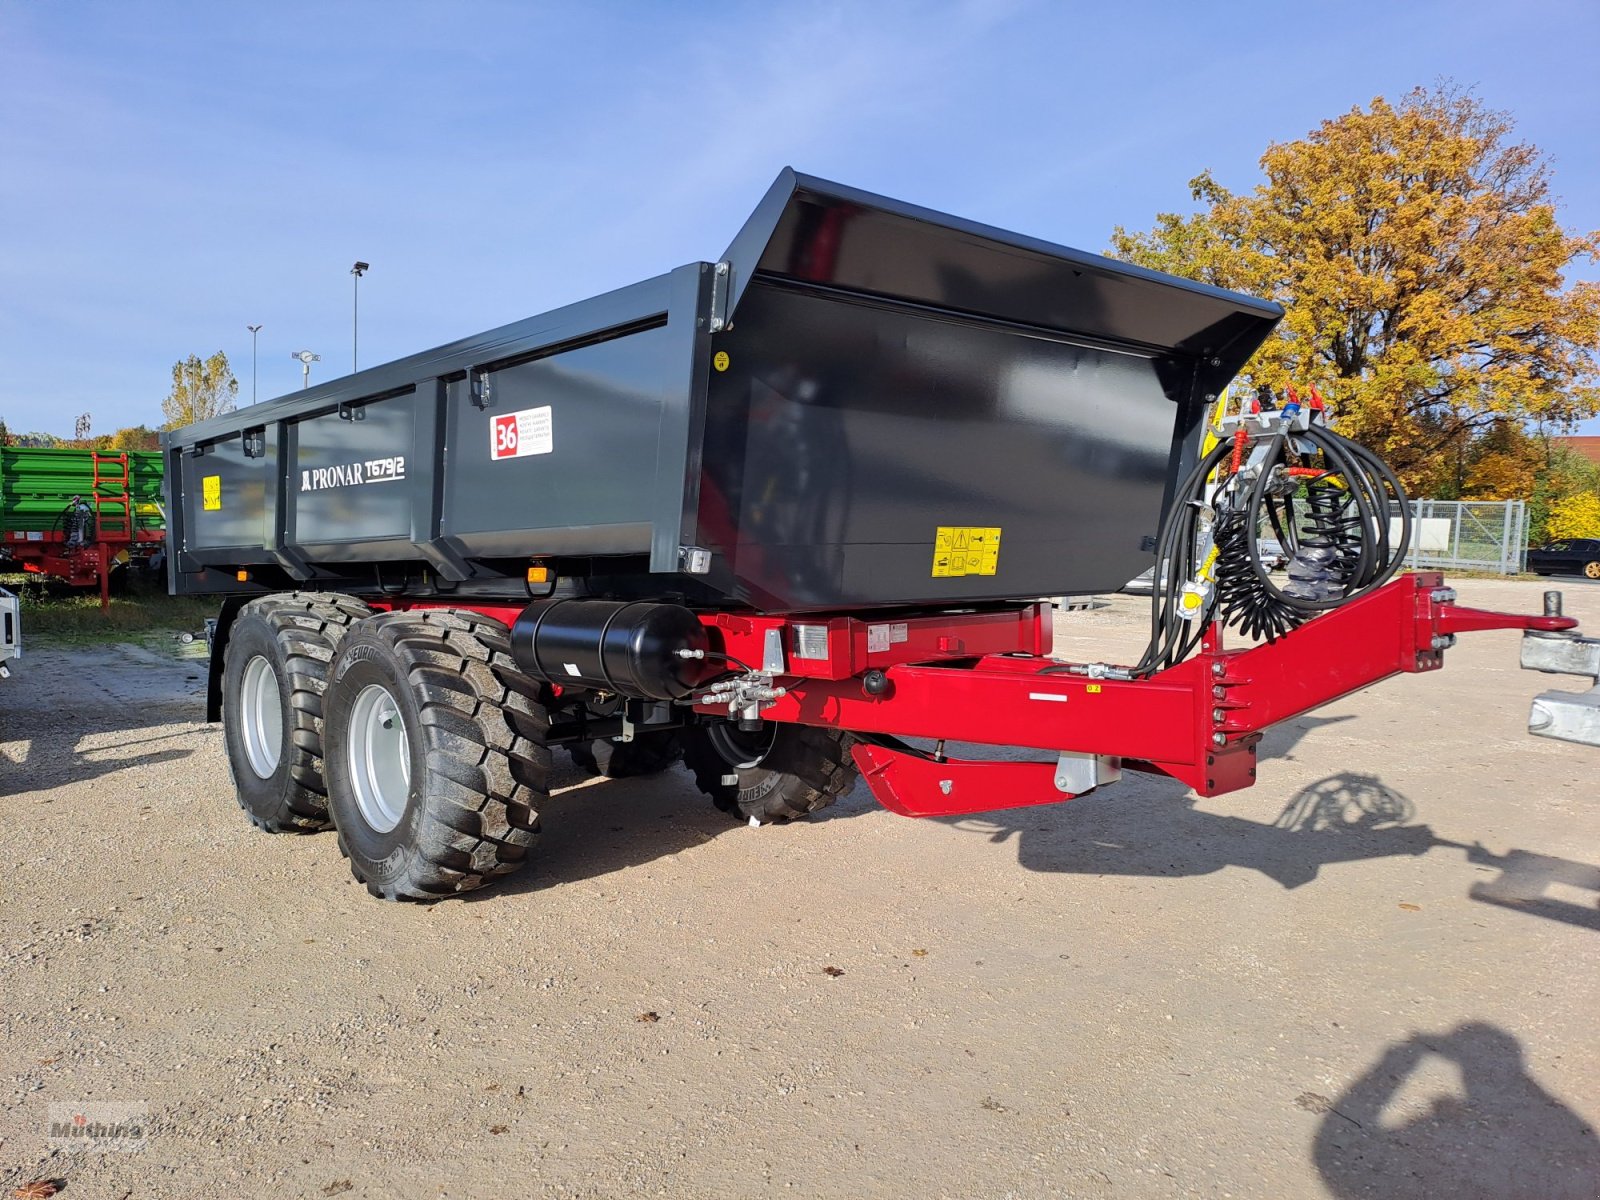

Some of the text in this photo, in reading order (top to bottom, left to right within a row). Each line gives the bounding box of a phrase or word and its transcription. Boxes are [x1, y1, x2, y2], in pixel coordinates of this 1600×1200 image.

[497, 422, 517, 451] 36
[312, 456, 405, 490] PRONAR T679/2
